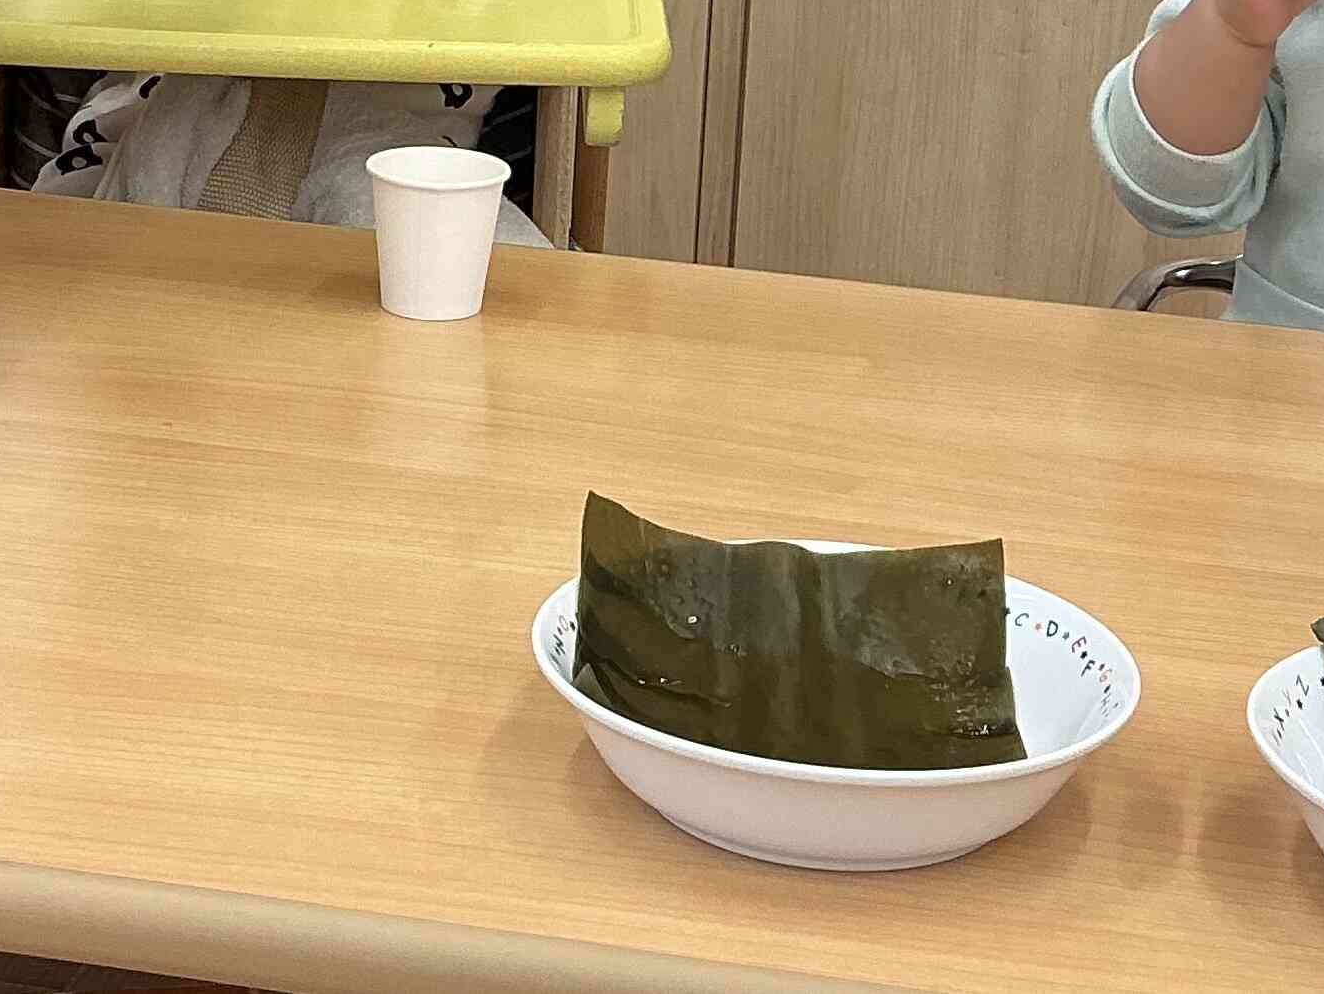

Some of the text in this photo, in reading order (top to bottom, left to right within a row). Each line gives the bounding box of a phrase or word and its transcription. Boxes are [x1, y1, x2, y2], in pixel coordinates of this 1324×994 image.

[1014, 612, 1030, 627] C
[1046, 619, 1059, 638] D
[1071, 636, 1088, 654] E
[1080, 659, 1096, 677] F
[1295, 674, 1310, 697] Z
